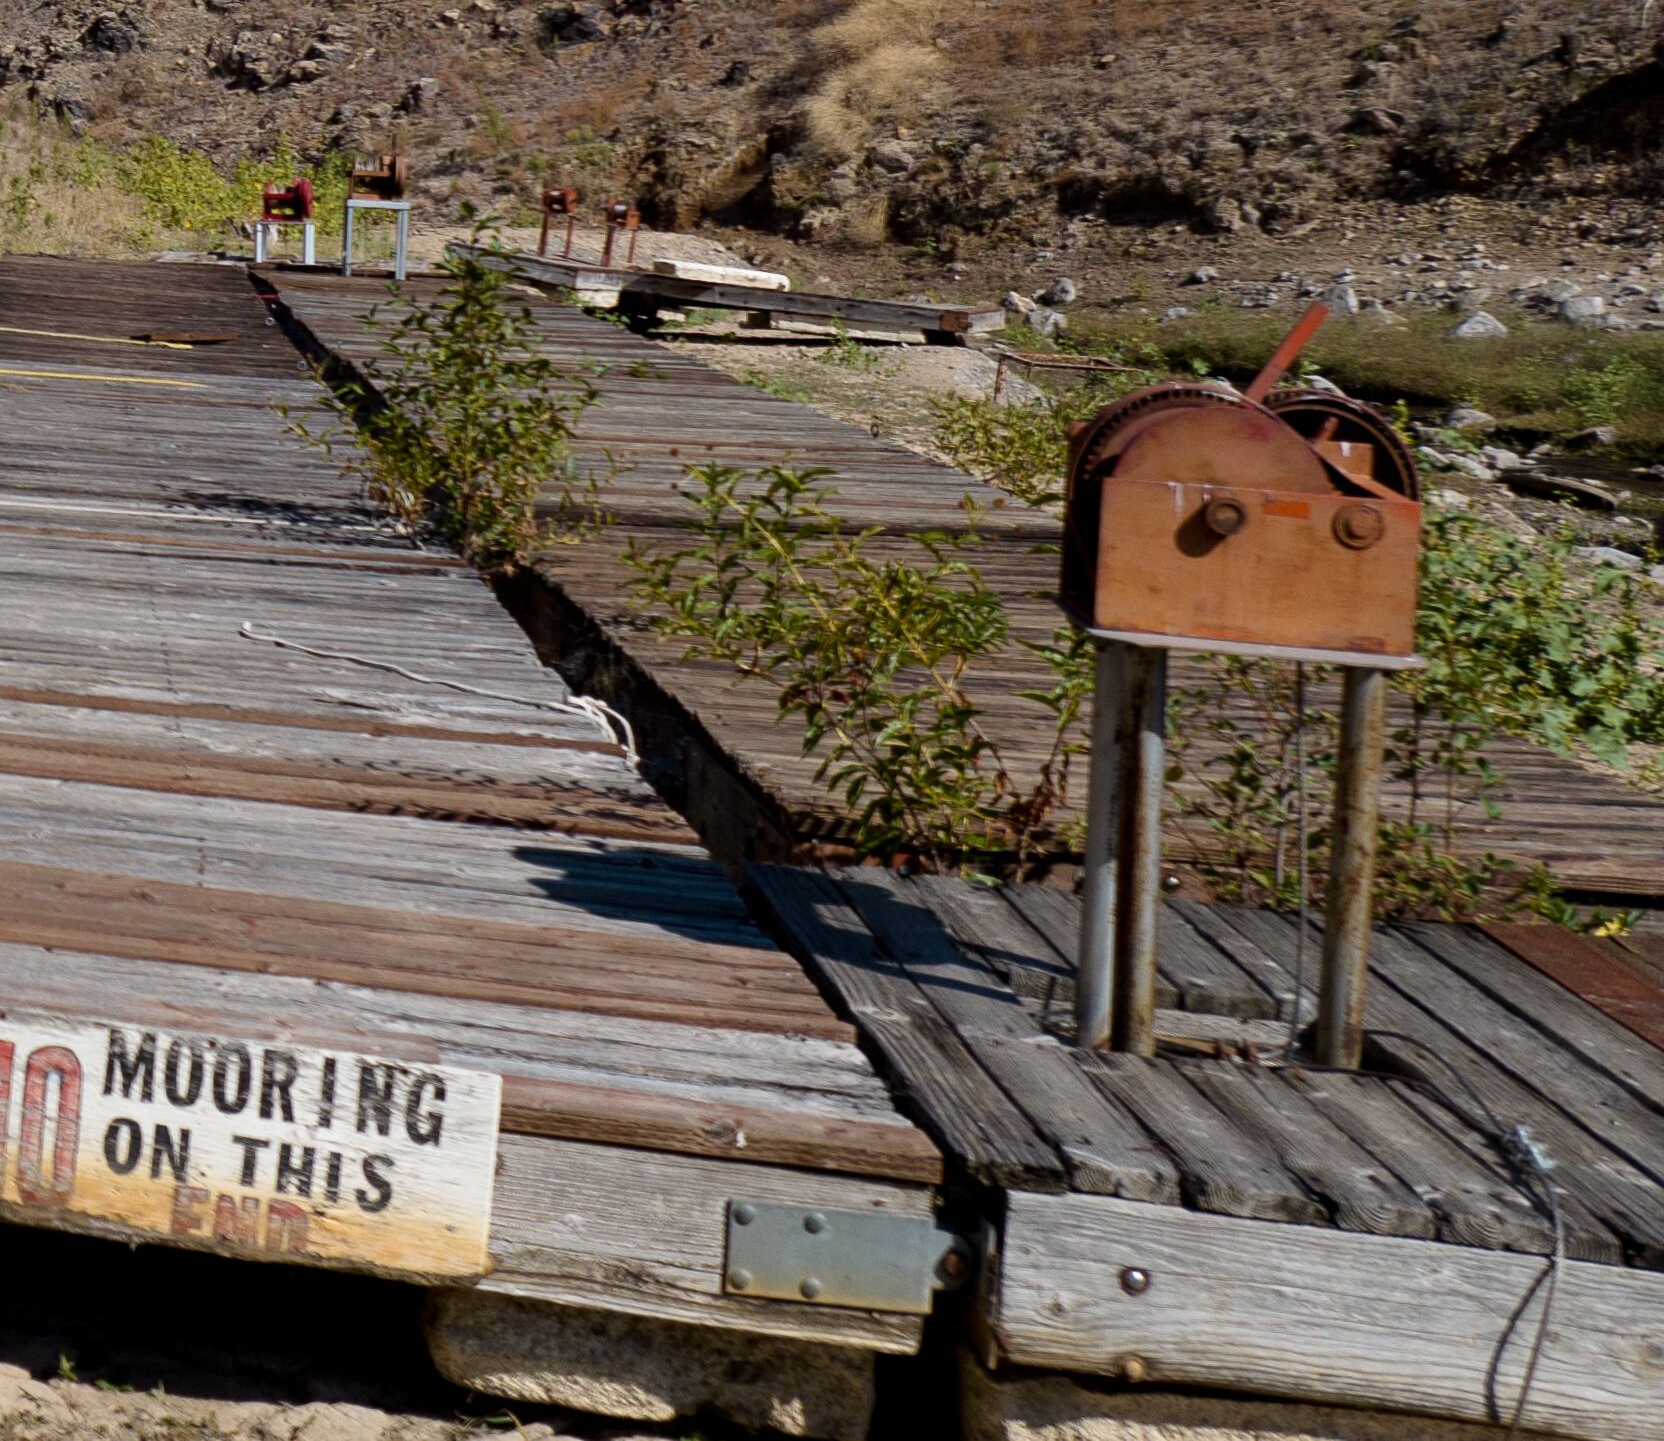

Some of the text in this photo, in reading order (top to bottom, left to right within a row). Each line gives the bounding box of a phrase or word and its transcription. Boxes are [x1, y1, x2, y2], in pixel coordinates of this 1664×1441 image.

[102, 1027, 449, 1148] MOORING
[103, 1116, 397, 1214] ON THIS
